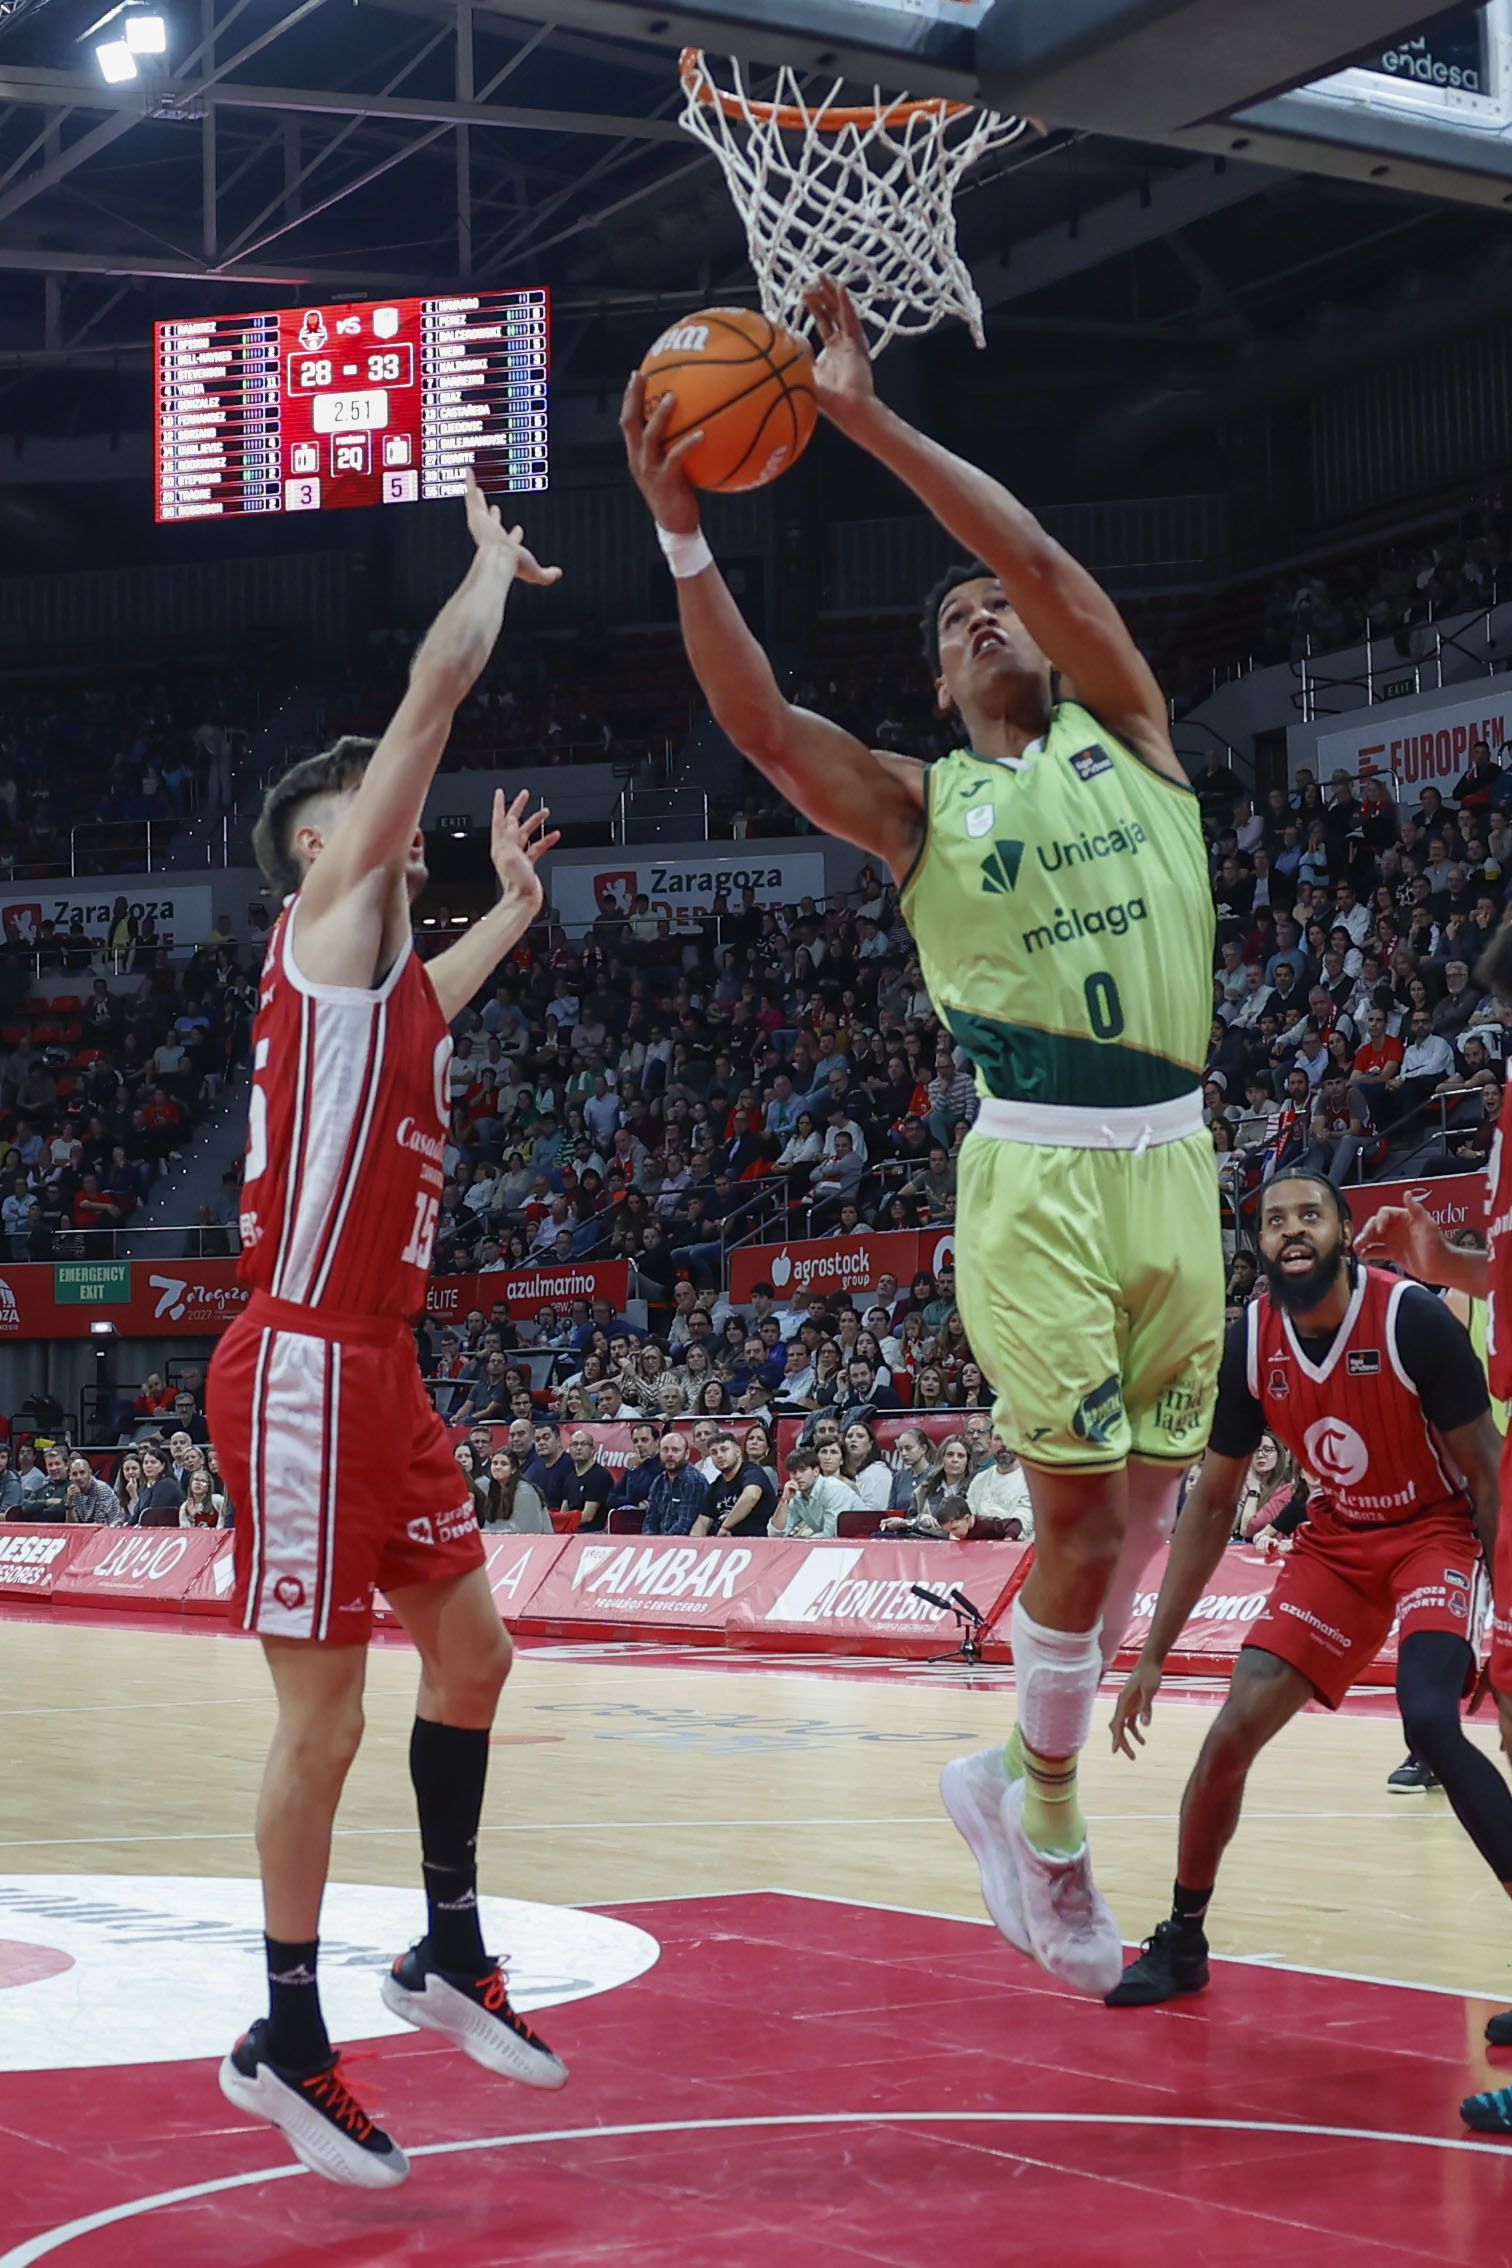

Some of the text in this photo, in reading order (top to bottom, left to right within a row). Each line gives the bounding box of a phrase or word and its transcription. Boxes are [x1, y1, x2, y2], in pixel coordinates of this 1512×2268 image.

[1382, 50, 1479, 90] endesa
[301, 359, 332, 387] 28
[368, 353, 399, 381] 33
[337, 446, 364, 472] 2Q
[301, 485, 313, 505] 3
[391, 478, 403, 498] 5
[1036, 818, 1148, 873] Unicaja
[651, 869, 782, 897] Zaragoza
[54, 900, 174, 925] Zaraoza
[1084, 971, 1125, 1040] 0
[400, 1191, 439, 1270] 15
[59, 1266, 126, 1283] EMERGENCY
[793, 1246, 870, 1286] agrostock
[80, 1284, 105, 1300] EXIT
[506, 1269, 596, 1301] azulmarino
[842, 1272, 870, 1290] group
[187, 1308, 213, 1322] 2027
[586, 1547, 752, 1600] AMBAR
[593, 1597, 642, 1610] PEQUEÑOS
[643, 1601, 708, 1613] CERVECEROS
[1279, 1602, 1352, 1648] azulmarino
